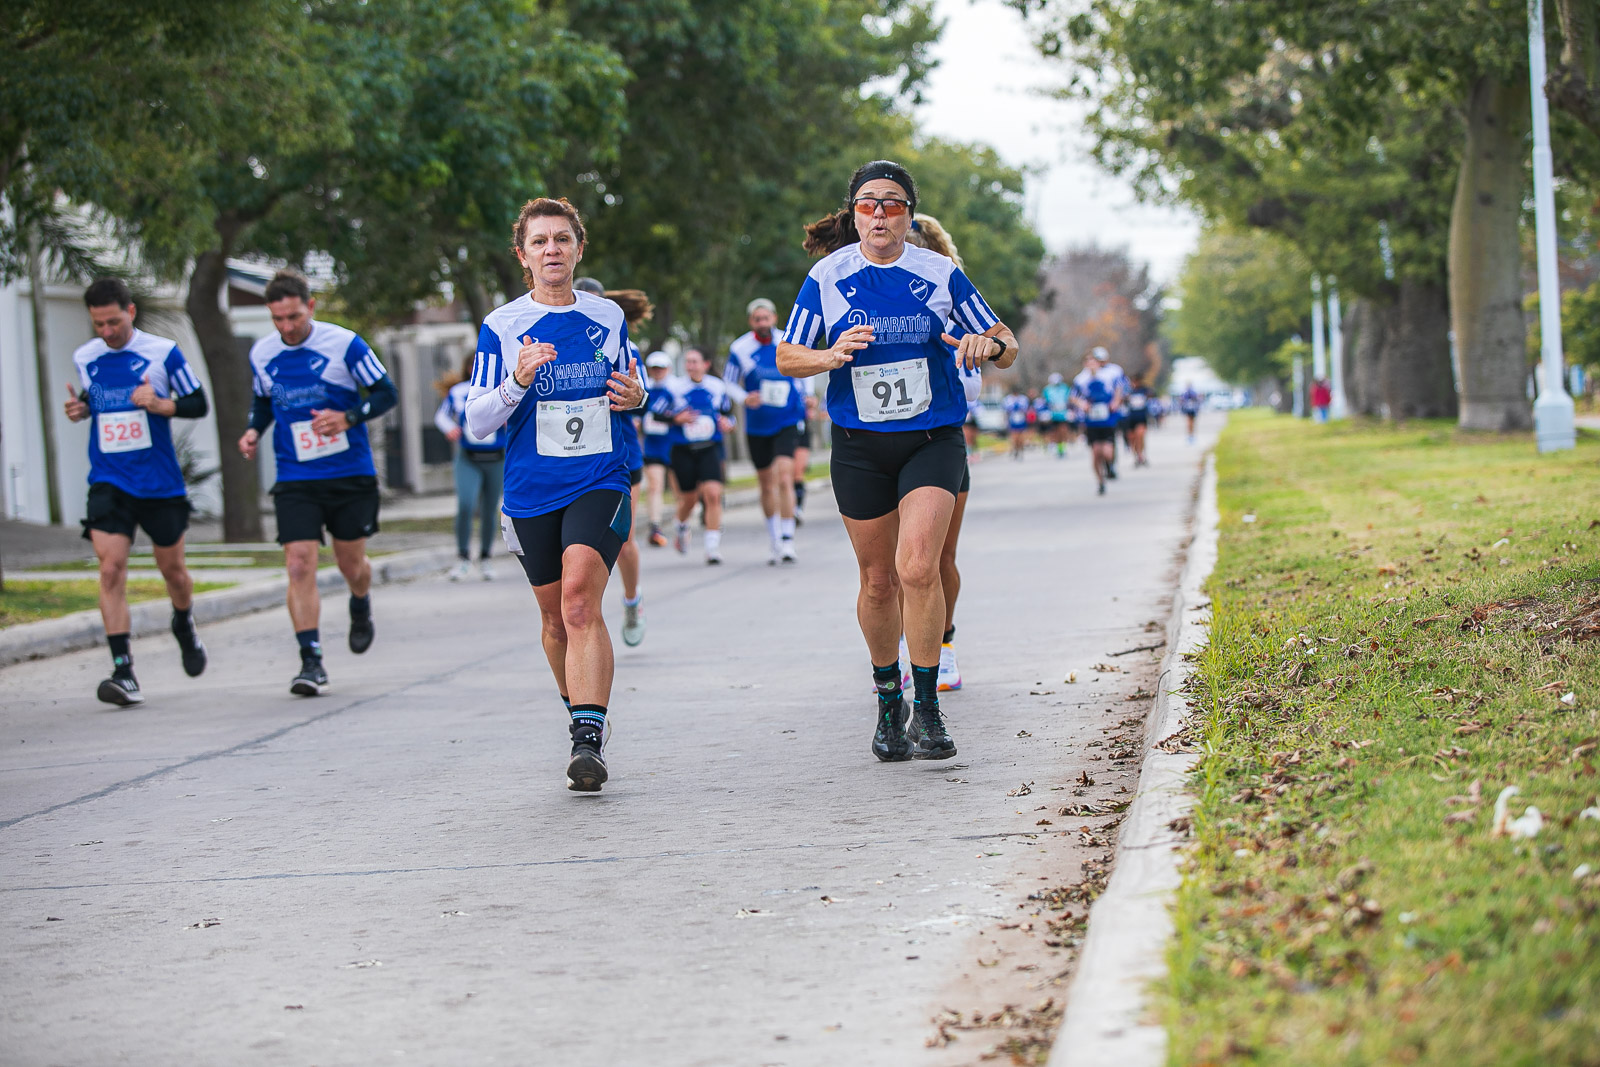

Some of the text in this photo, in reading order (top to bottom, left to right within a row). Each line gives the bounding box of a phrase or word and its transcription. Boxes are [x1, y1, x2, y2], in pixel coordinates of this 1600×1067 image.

[870, 312, 931, 334] MARATÓN
[872, 378, 913, 408] 91
[104, 421, 144, 443] 528
[566, 417, 585, 443] 9
